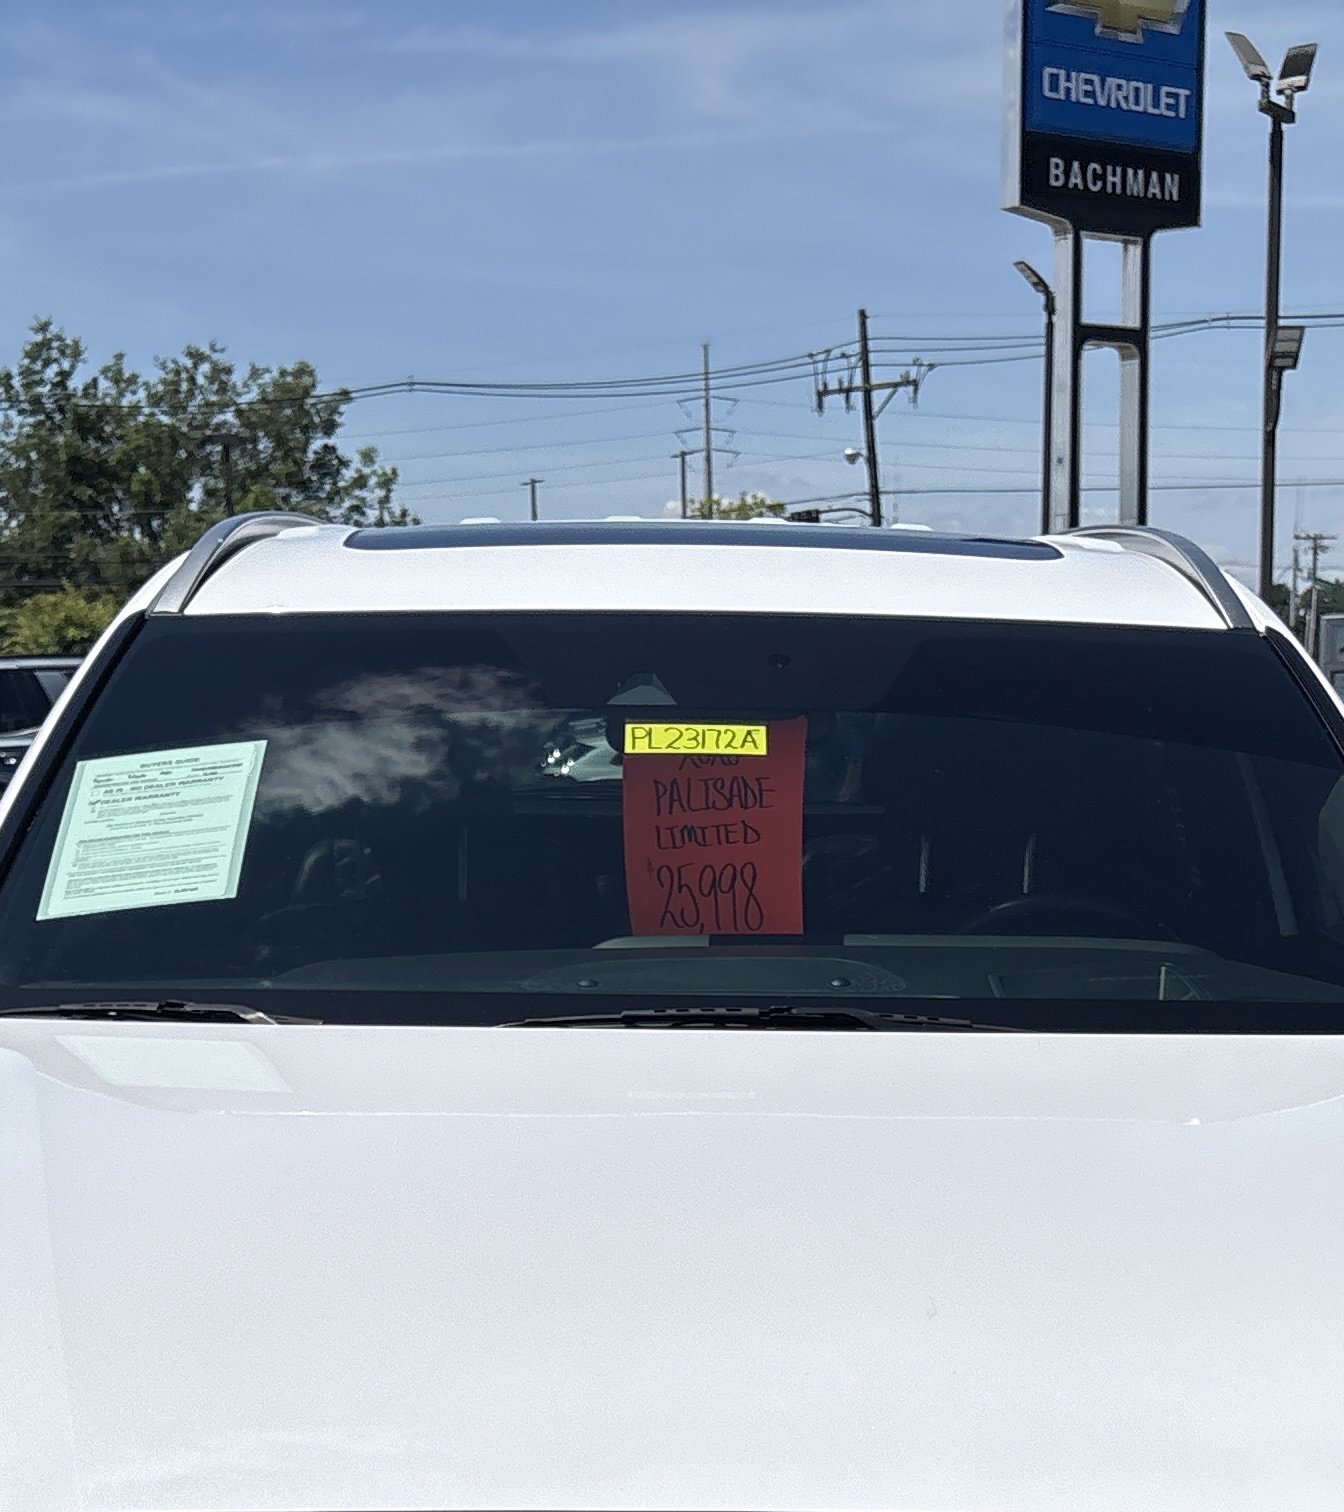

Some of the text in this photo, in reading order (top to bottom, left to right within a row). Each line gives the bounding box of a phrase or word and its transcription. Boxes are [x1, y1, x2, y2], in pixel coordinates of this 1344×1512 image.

[1041, 65, 1192, 119] CHEVROLET
[1048, 156, 1181, 202] BACHMAN
[630, 726, 760, 751] PL23172A
[653, 775, 777, 817] PALISADE
[655, 819, 762, 851] LIMITED
